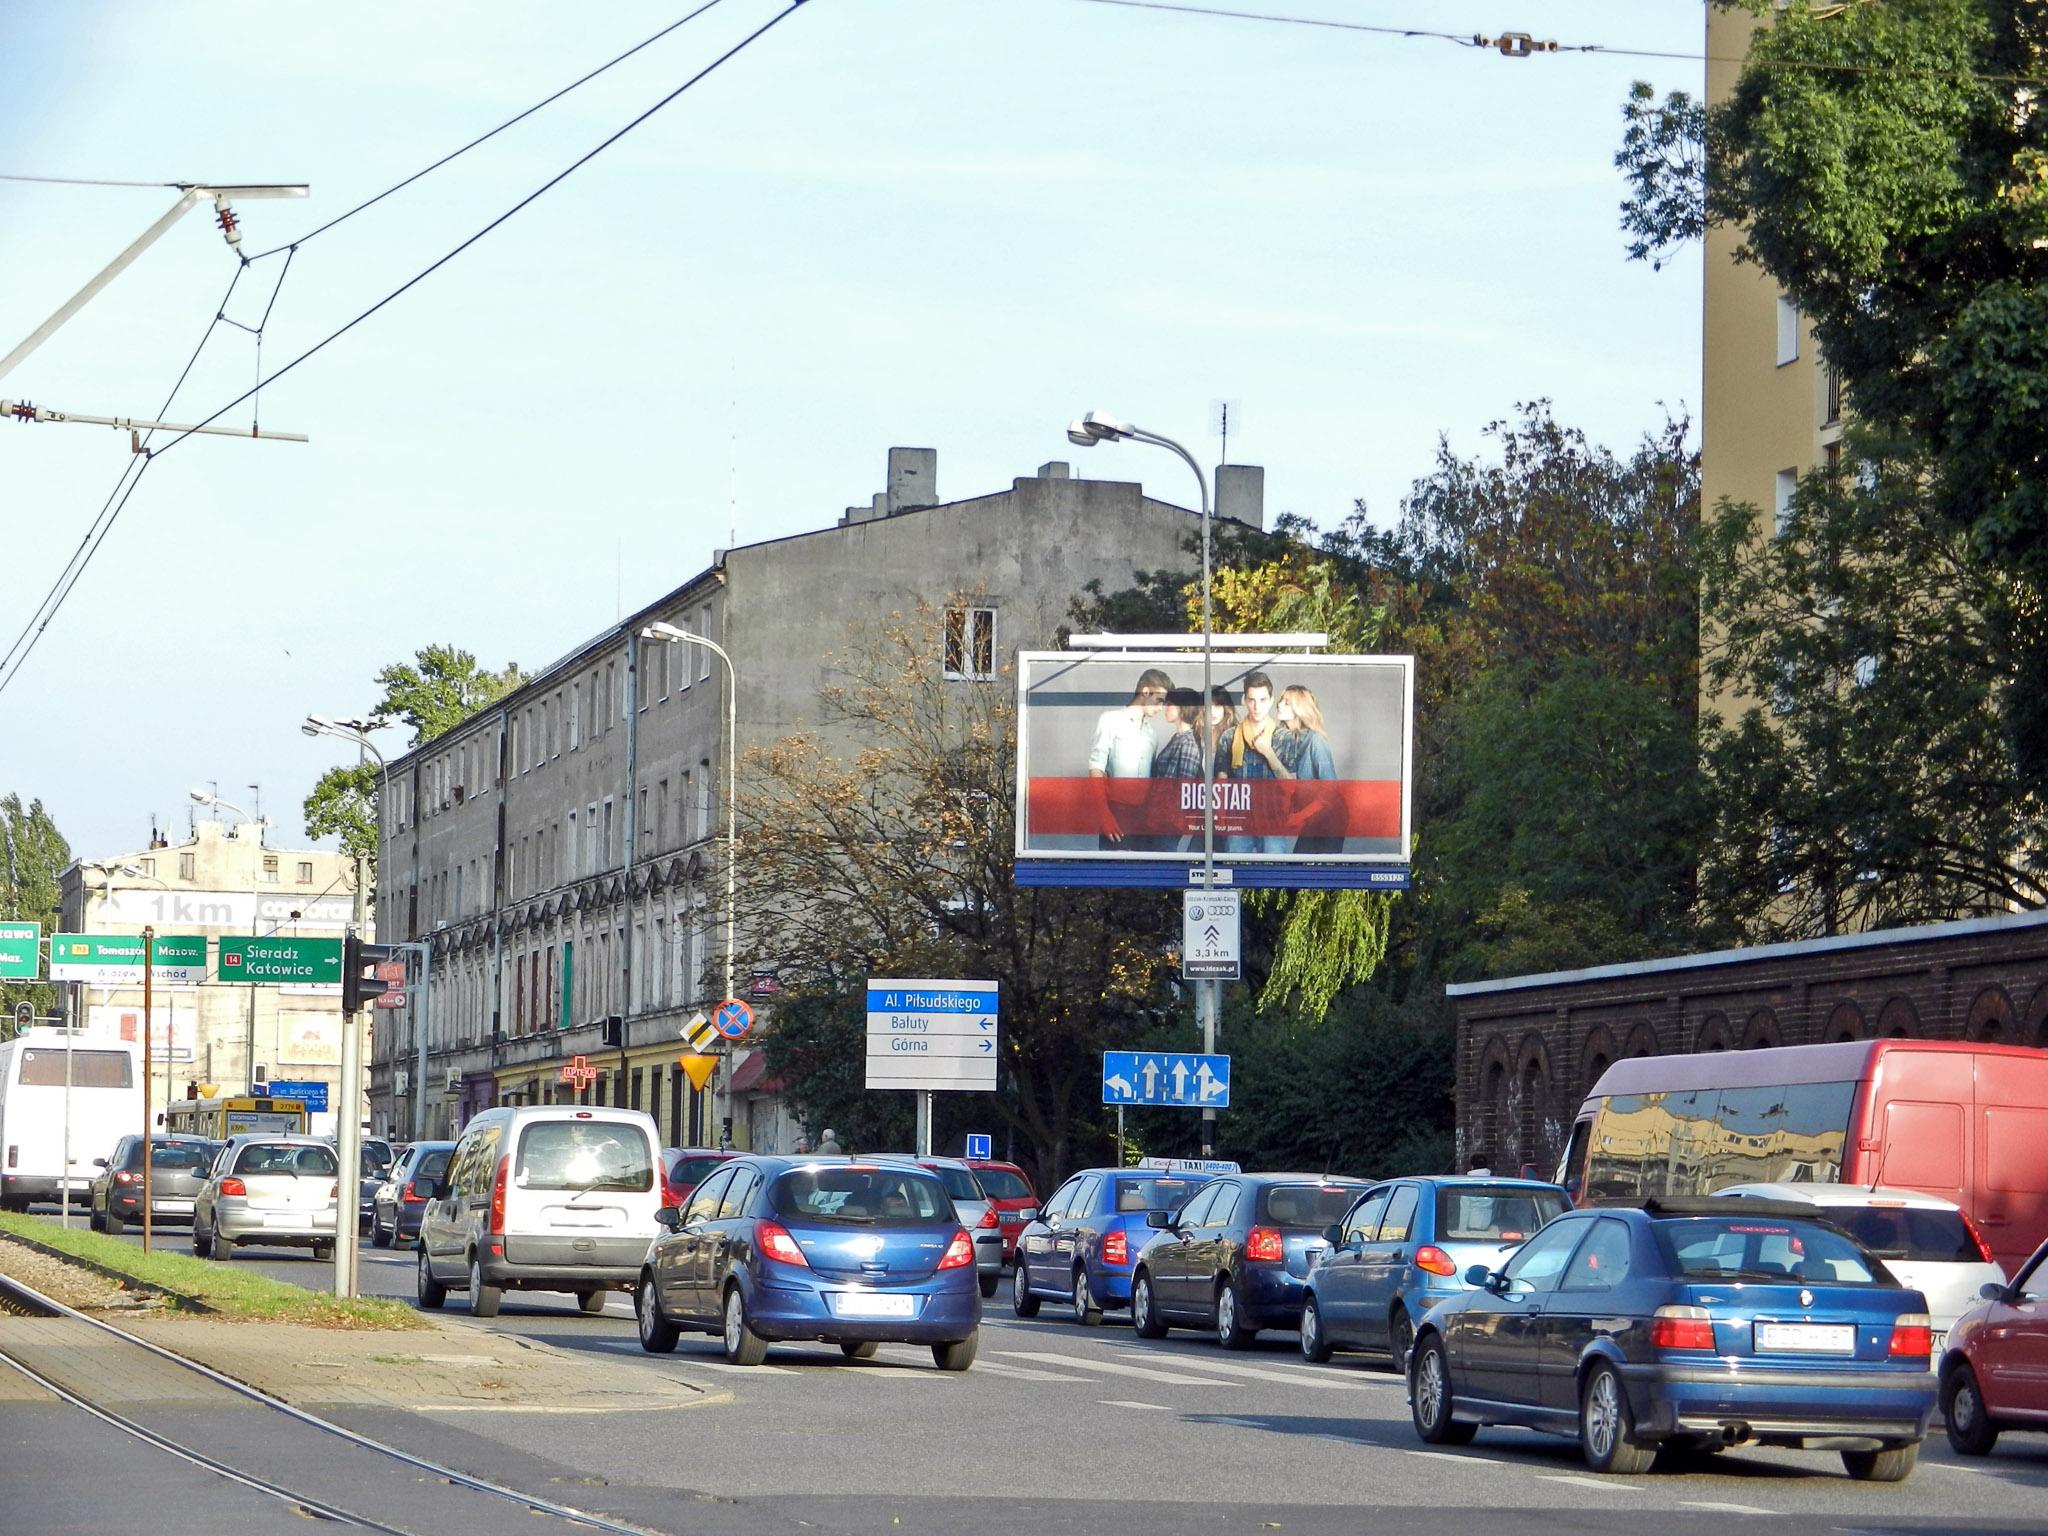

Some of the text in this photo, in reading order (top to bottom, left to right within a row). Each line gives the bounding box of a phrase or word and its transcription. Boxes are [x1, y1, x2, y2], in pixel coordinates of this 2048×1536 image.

[1181, 783, 1251, 811] BIG STAR
[159, 946, 198, 956] Mazow.
[247, 945, 299, 959] Sieradz
[1195, 949, 1229, 958] 3,3 km
[246, 962, 313, 975] Katowice
[885, 994, 981, 1012] Al. Piłsudskiego
[891, 1016, 929, 1032] Bałuty
[891, 1037, 928, 1051] Górna
[566, 1069, 595, 1077] APTEKA
[975, 1138, 984, 1154] L
[1184, 1161, 1202, 1170] TAXI
